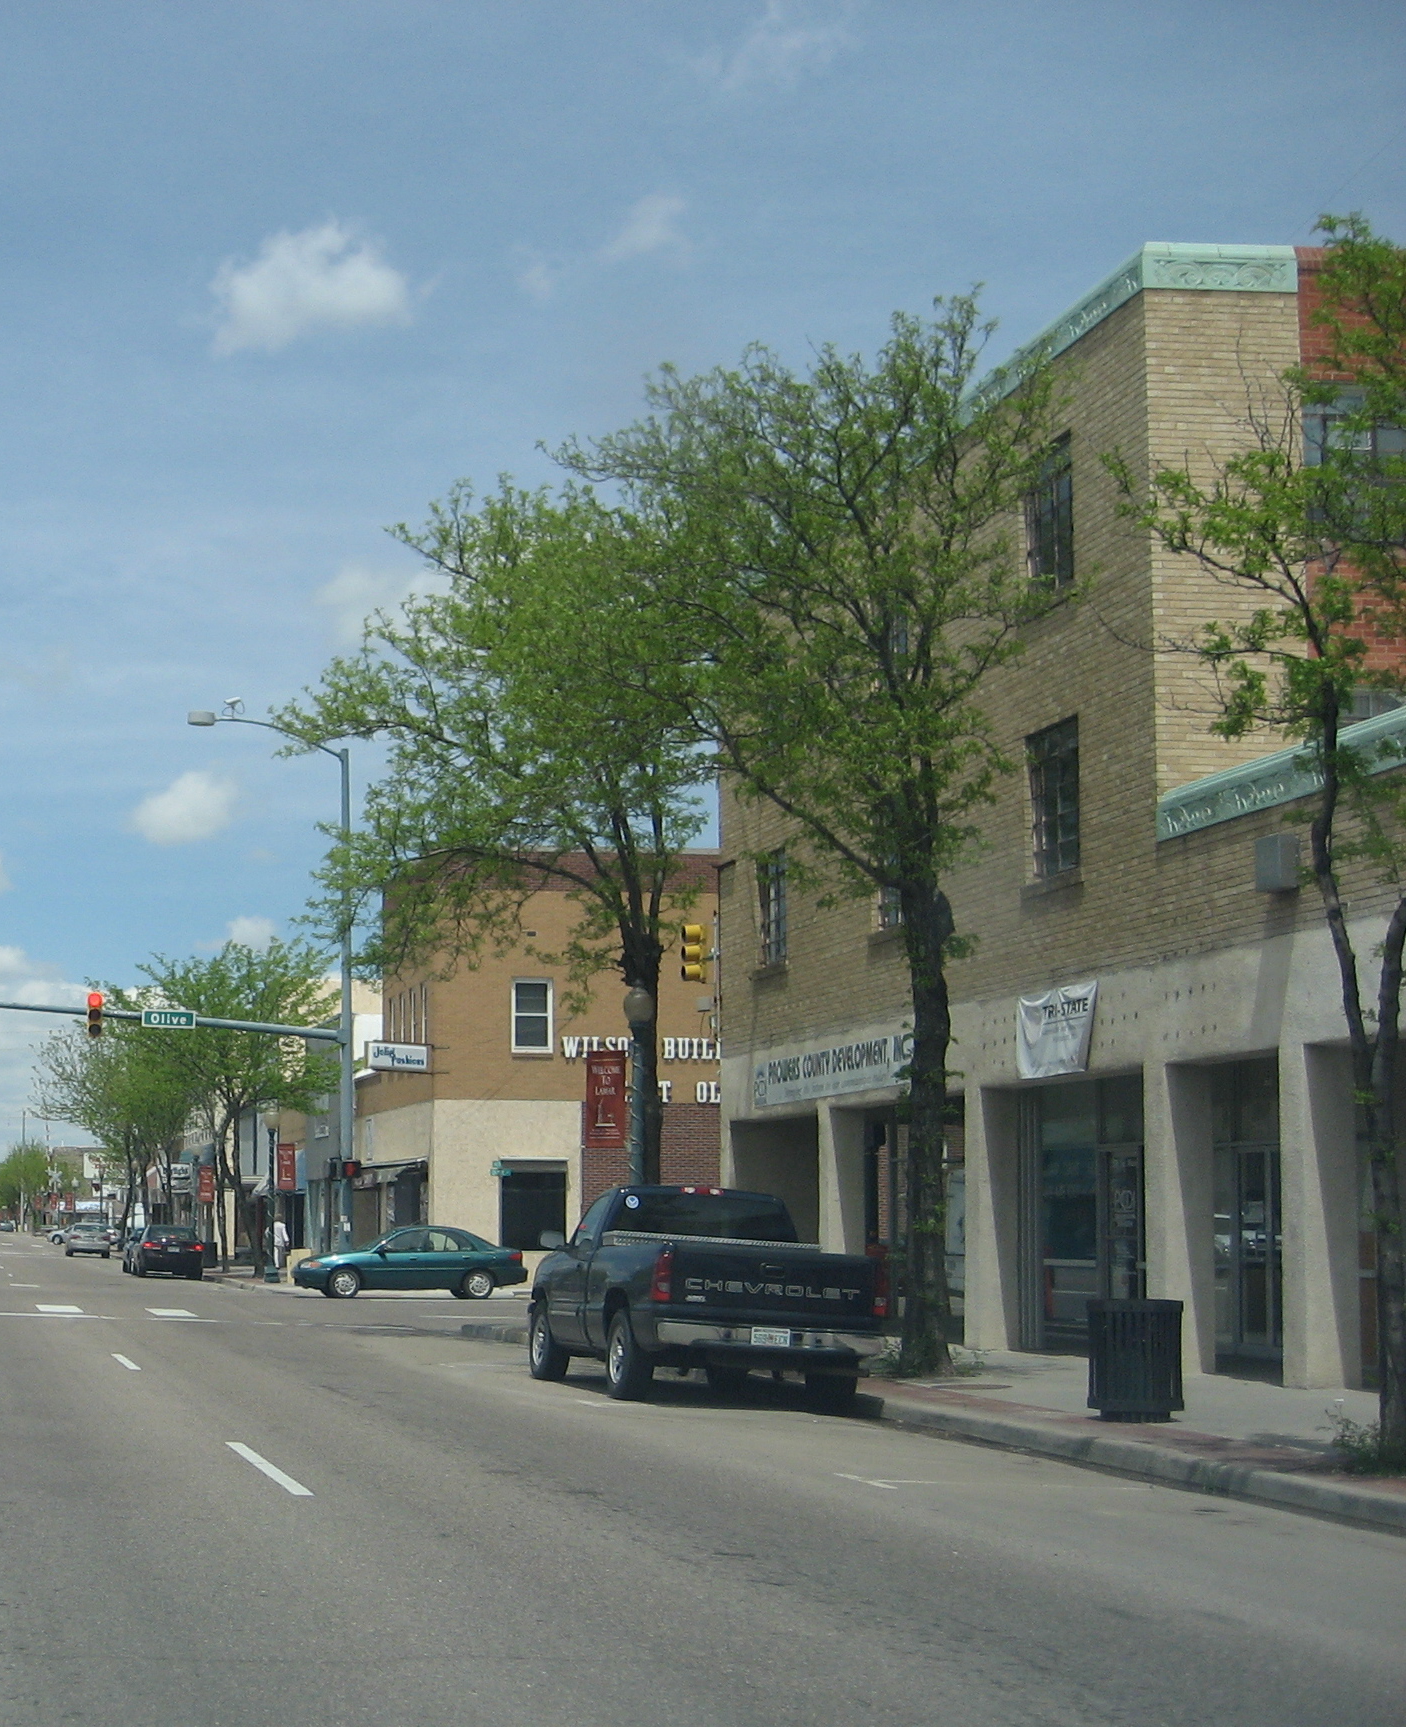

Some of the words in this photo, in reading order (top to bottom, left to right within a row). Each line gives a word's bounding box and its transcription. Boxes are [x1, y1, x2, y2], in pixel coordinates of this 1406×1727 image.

[150, 1013, 187, 1025] Olive
[1042, 998, 1088, 1019] TRI-STATE
[562, 1036, 634, 1058] WILSO
[591, 1065, 621, 1075] WELCOME
[768, 1056, 800, 1085] PROWERS
[803, 1050, 831, 1078] COUNTY
[685, 1277, 860, 1300] CHEVROLET
